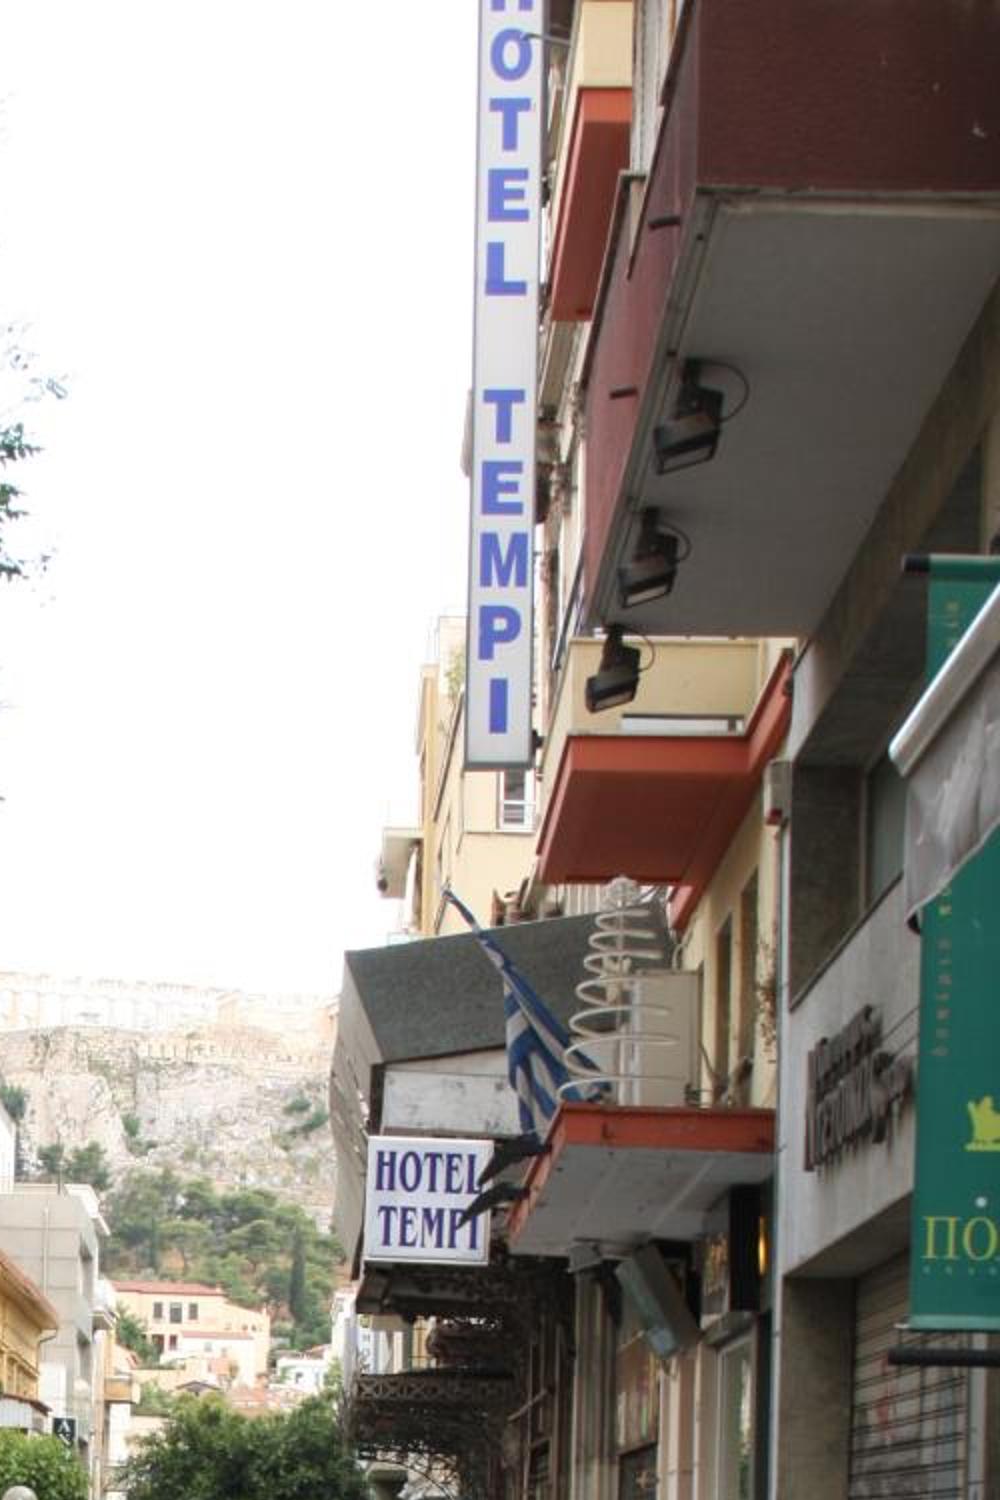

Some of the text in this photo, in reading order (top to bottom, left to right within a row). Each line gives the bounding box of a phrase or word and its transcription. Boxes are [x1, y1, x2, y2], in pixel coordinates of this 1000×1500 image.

[477, 0, 533, 734] OTEL TEMPI
[375, 1150, 482, 1195] HOTEL
[921, 1215, 1000, 1261] ΠΟ
